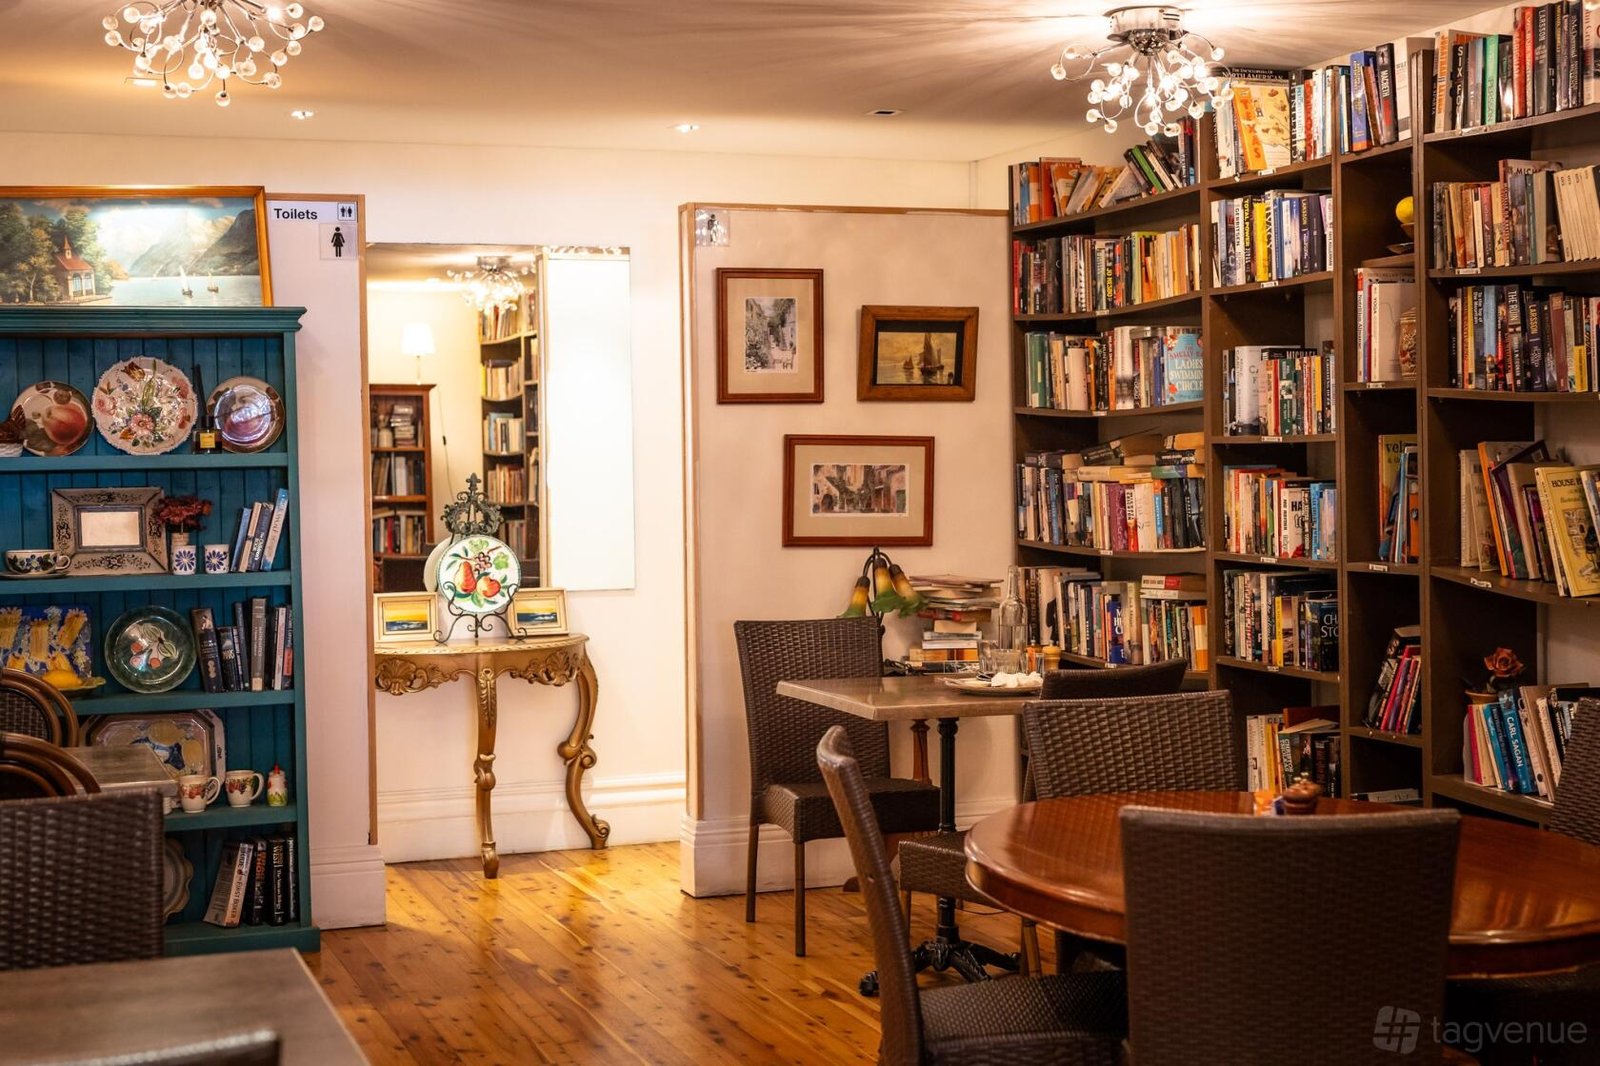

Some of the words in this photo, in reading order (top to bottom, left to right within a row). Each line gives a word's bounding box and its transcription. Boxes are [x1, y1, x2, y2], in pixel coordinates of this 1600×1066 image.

[273, 208, 318, 220] Toilets
[1508, 291, 1517, 305] THE
[1529, 304, 1538, 335] LARSSON
[1507, 716, 1516, 738] CARL
[1511, 739, 1523, 767] SAGAN
